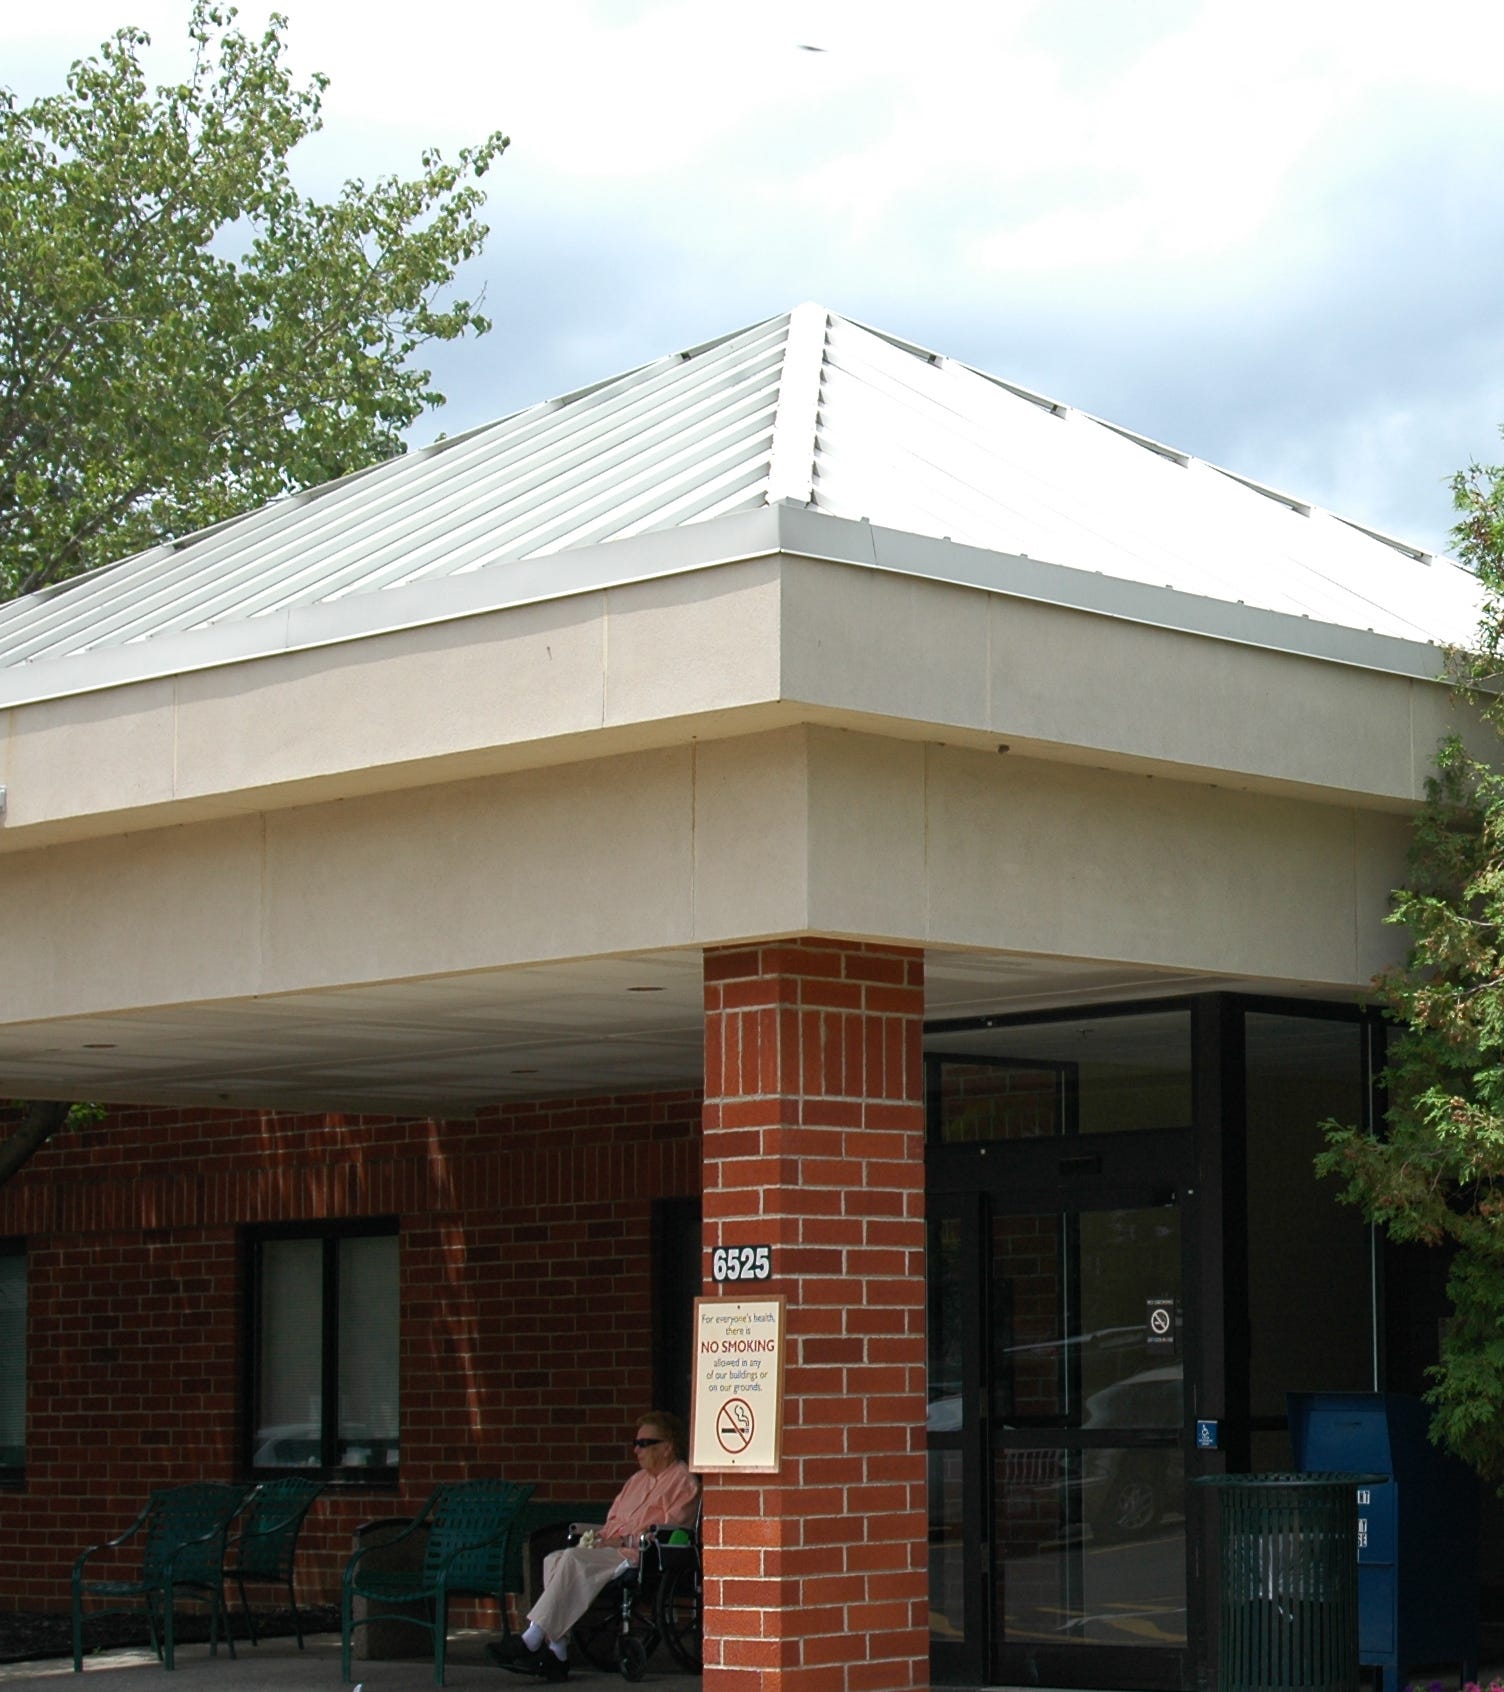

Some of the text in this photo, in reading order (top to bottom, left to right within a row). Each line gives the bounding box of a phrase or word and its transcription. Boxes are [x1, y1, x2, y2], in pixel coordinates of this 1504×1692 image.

[713, 1247, 770, 1281] 6525
[701, 1314, 713, 1323] For
[716, 1313, 752, 1325] everyone's
[726, 1326, 751, 1335] there is
[701, 1339, 775, 1354] NO SMOKING
[714, 1358, 761, 1369] allowed in any
[706, 1370, 714, 1380] of
[730, 1370, 758, 1382] buildings
[760, 1371, 768, 1379] or
[708, 1384, 717, 1392] on
[720, 1384, 731, 1392] our
